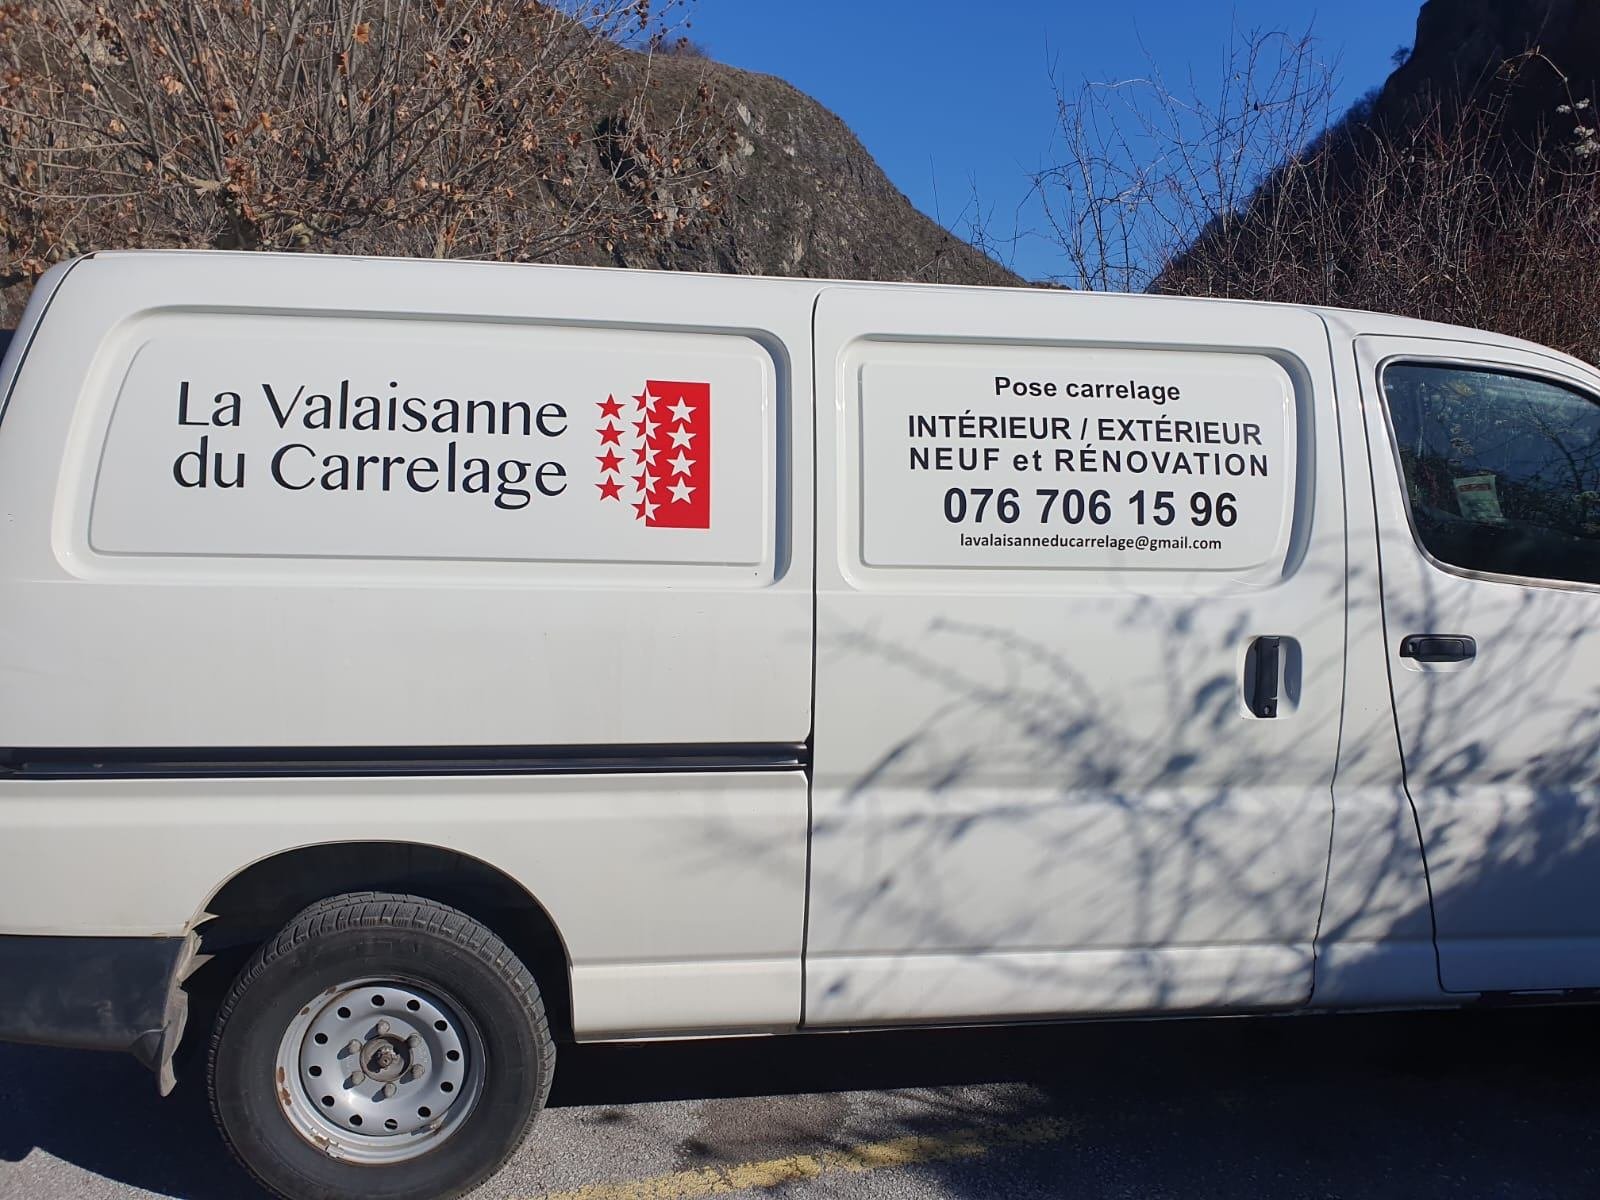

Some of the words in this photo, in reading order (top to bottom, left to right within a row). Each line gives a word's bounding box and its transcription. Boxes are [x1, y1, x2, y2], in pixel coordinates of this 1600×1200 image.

[178, 381, 241, 427] La
[261, 379, 568, 438] Valaisanne
[995, 376, 1057, 397] Pose
[1065, 380, 1180, 406] carrelage
[908, 409, 1072, 440] INTÉRIEUR
[1080, 417, 1088, 441] /
[1097, 414, 1262, 446] EXTÉRIEUR
[172, 435, 245, 489] du
[270, 441, 568, 510] Carrelage
[910, 447, 1000, 471] NEUF
[1013, 449, 1043, 472] et
[1055, 443, 1268, 477] RÉNOVATION
[943, 487, 1020, 524] 076
[1036, 488, 1112, 525] 706
[1128, 489, 1176, 526] 15
[1190, 491, 1238, 528] 96
[960, 533, 1222, 552] lavalaisanneducarrelage@gmail.com
